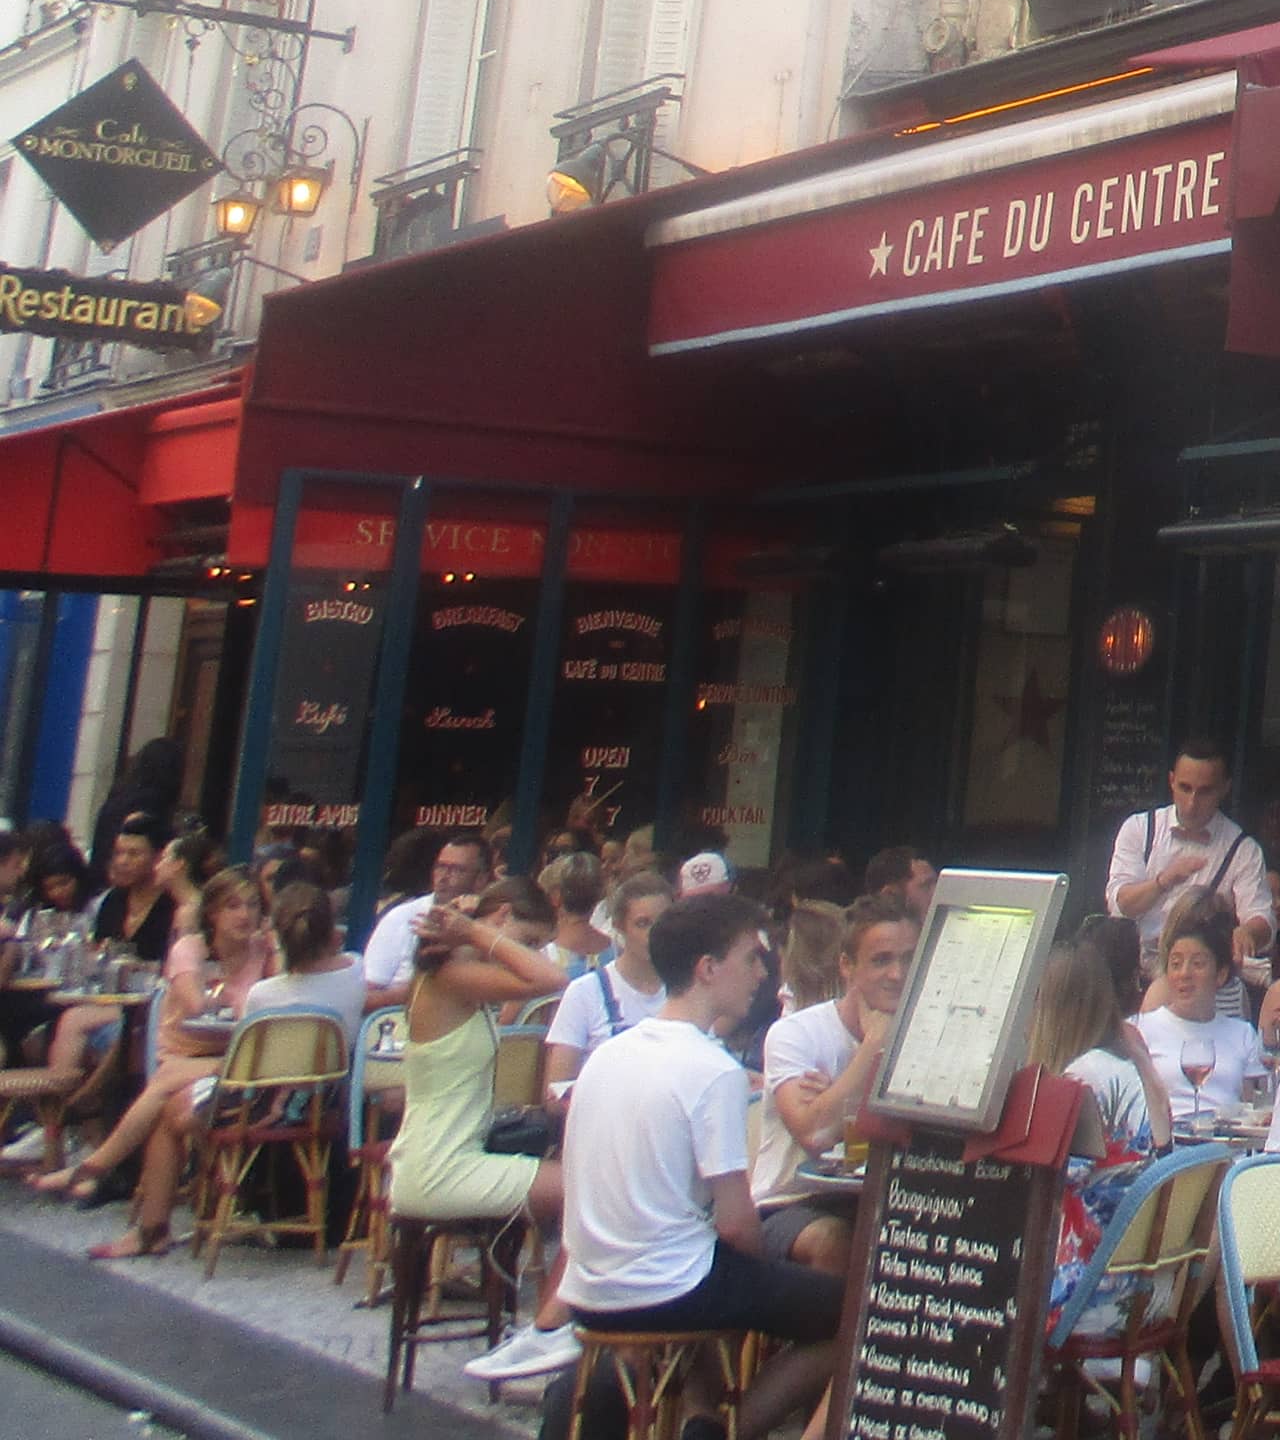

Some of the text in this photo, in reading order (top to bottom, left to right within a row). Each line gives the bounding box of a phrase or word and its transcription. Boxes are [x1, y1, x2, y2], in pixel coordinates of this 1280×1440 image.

[38, 137, 197, 172] MONTORGUEIL
[902, 151, 1225, 278] CAFE DU CENTRE
[355, 519, 511, 554] SEVICE
[305, 599, 374, 626] BISTRO
[431, 605, 525, 634] BREAKFAST
[576, 609, 664, 638] BIENVENUE
[621, 661, 667, 682] CENTRE
[583, 746, 631, 769] OPEN
[417, 804, 487, 826] DINNER
